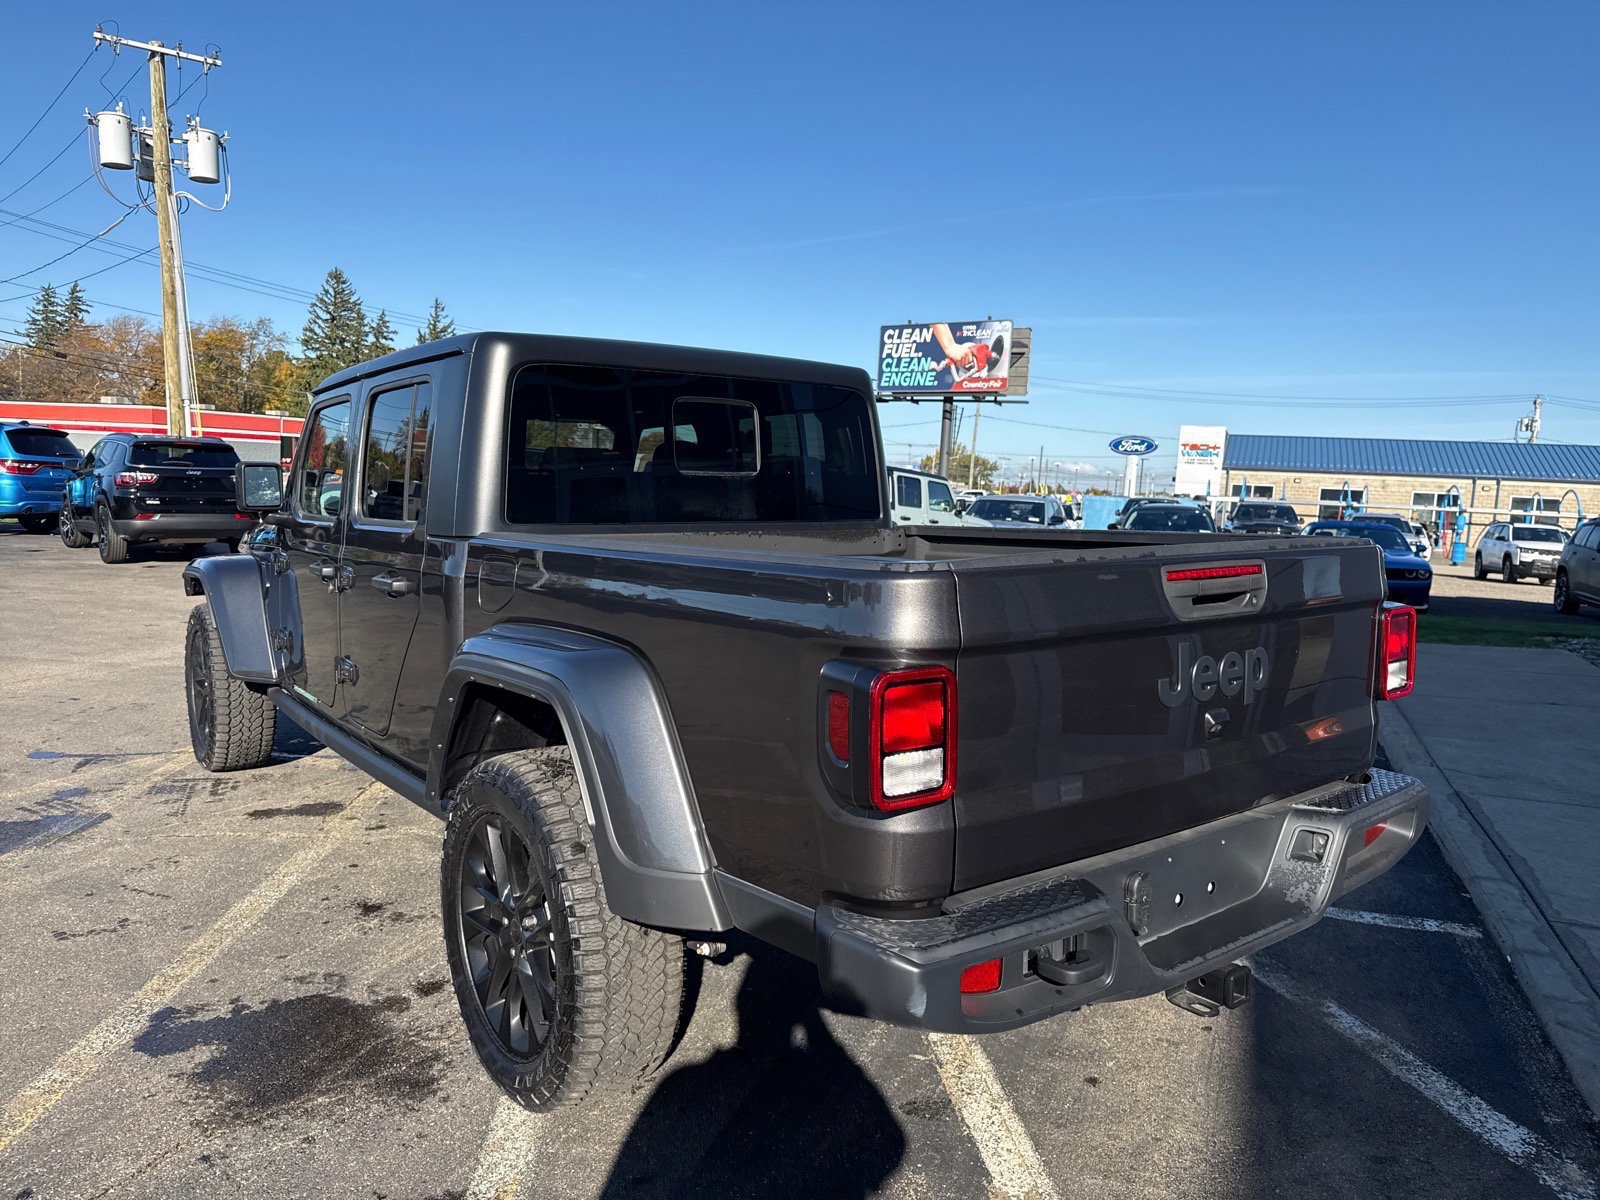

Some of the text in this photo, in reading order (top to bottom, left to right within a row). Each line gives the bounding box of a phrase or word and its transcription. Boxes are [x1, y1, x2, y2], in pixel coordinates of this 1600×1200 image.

[883, 327, 933, 343] CLEAN
[882, 343, 922, 358] FUEL.
[882, 357, 931, 372] CLEAN
[880, 371, 938, 387] ENGINE.
[962, 380, 988, 389] Country
[1119, 440, 1148, 451] Ford
[1158, 642, 1269, 708] Jeep
